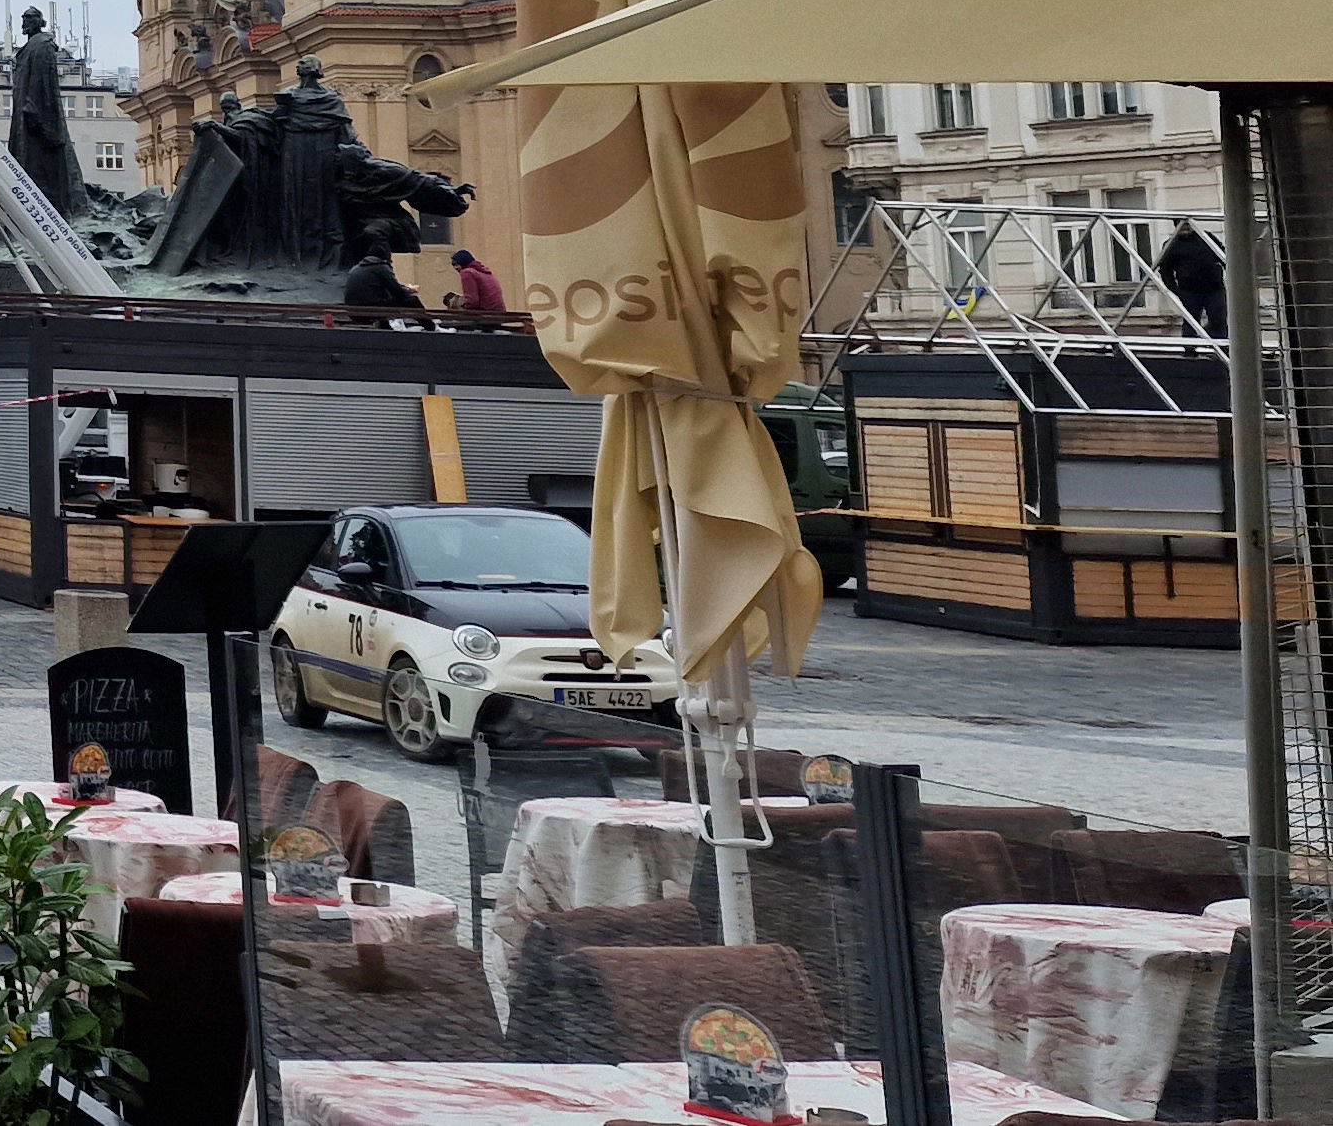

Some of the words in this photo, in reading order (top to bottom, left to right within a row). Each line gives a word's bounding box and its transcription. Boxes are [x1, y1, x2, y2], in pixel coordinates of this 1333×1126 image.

[1, 154, 33, 195] pronájem
[30, 192, 69, 237] montážních
[11, 185, 30, 206] 602
[25, 204, 45, 226] 332
[42, 224, 60, 244] 632
[349, 613, 363, 657] 78
[69, 678, 139, 714] PIZZA
[567, 690, 596, 706] 5AE
[608, 692, 645, 707] 4422
